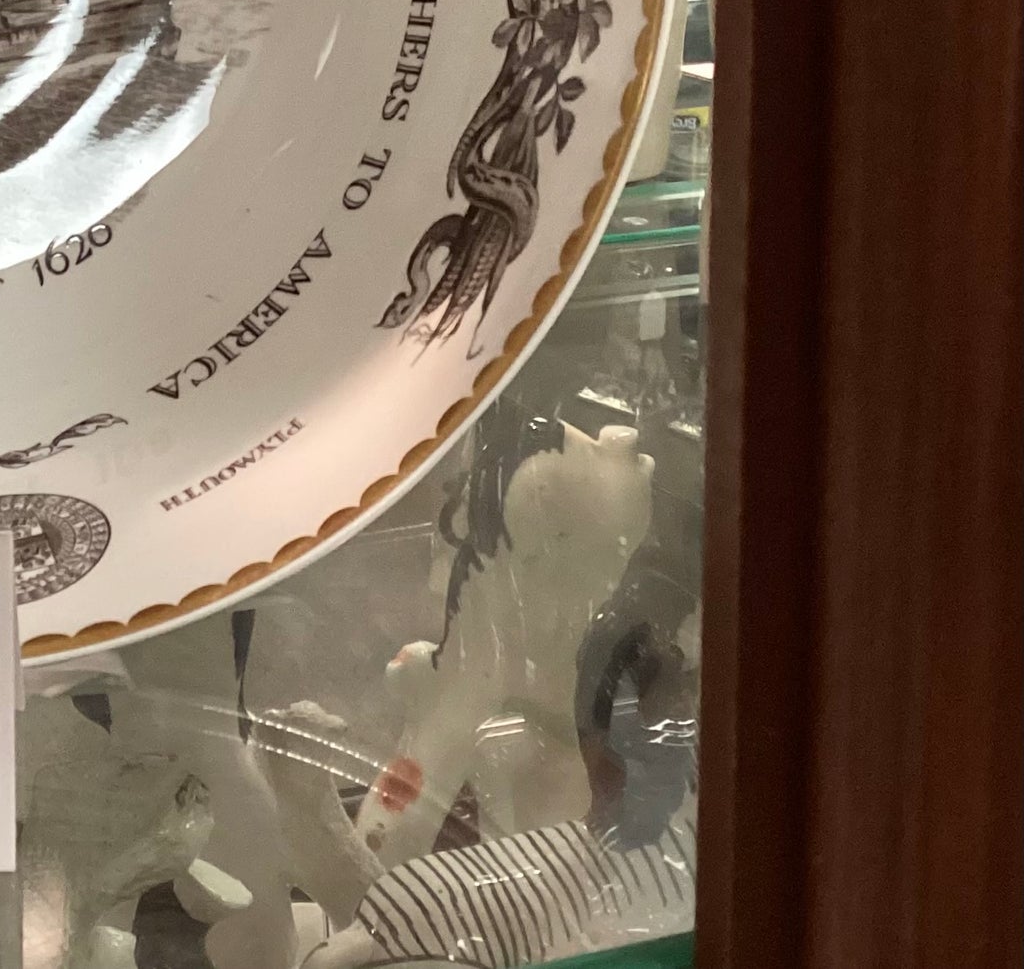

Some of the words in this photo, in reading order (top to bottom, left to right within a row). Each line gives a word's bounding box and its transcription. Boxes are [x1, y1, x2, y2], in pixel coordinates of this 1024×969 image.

[341, 147, 392, 211] TO
[31, 223, 113, 287] 1620
[146, 228, 333, 400] AMERICA
[159, 416, 306, 513] PLYMOUTH
